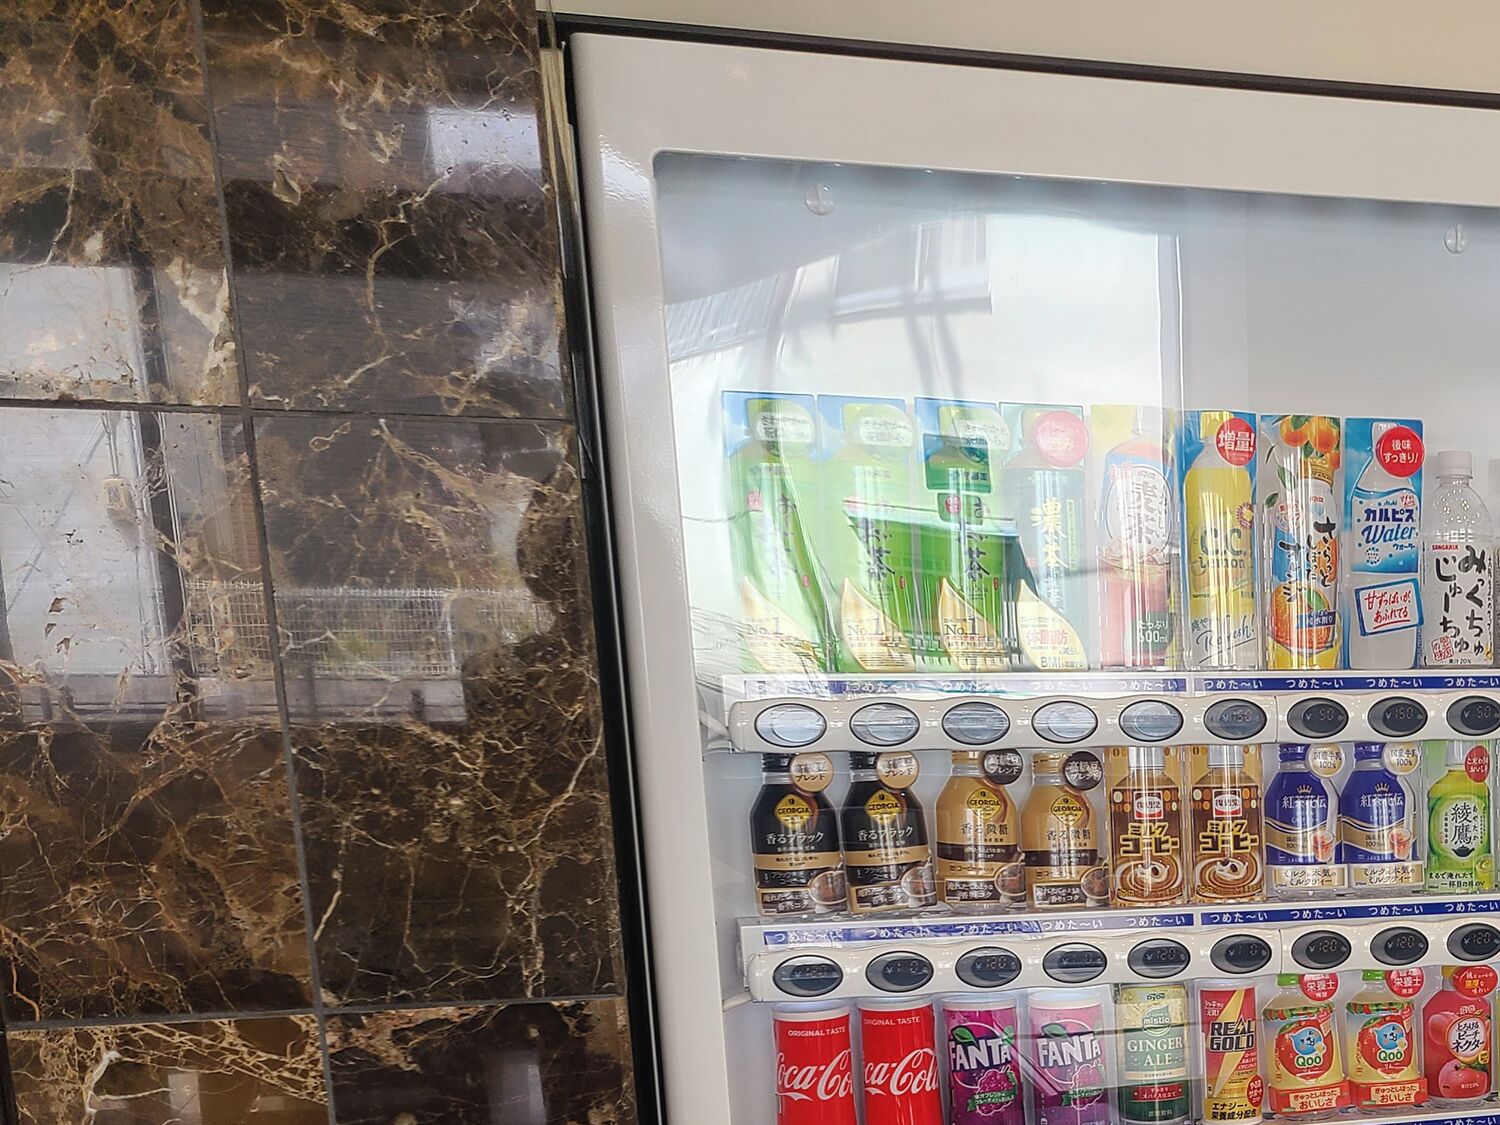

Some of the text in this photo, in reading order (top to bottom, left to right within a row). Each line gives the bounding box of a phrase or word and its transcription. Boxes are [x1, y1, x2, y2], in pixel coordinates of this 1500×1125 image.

[1391, 439, 1411, 451] 後味
[1364, 508, 1415, 523] カルピス
[1361, 525, 1416, 545] Water
[944, 617, 979, 636] No.1
[777, 806, 810, 815] GEORGIA
[867, 802, 900, 811] GEORGIA
[1451, 802, 1472, 845] 綾鷹
[1147, 992, 1166, 1000] DyDo
[1143, 1016, 1170, 1026] mistio
[1210, 1018, 1255, 1037] REAL
[788, 1026, 846, 1037] ORIGINAL TASTE
[1457, 1030, 1480, 1041] ピーチ
[1127, 1036, 1183, 1052] GINGER
[1209, 1034, 1254, 1052] GOLD
[1451, 1039, 1485, 1053] ネクター
[950, 1036, 1012, 1071] FANTA
[1036, 1033, 1100, 1068] FANTA
[1378, 1050, 1403, 1063] Qoo
[1143, 1053, 1173, 1067] ALE
[1295, 1055, 1322, 1067] Qoo
[1299, 1099, 1334, 1110] おいしさ
[1379, 1093, 1412, 1103] おいしさ
